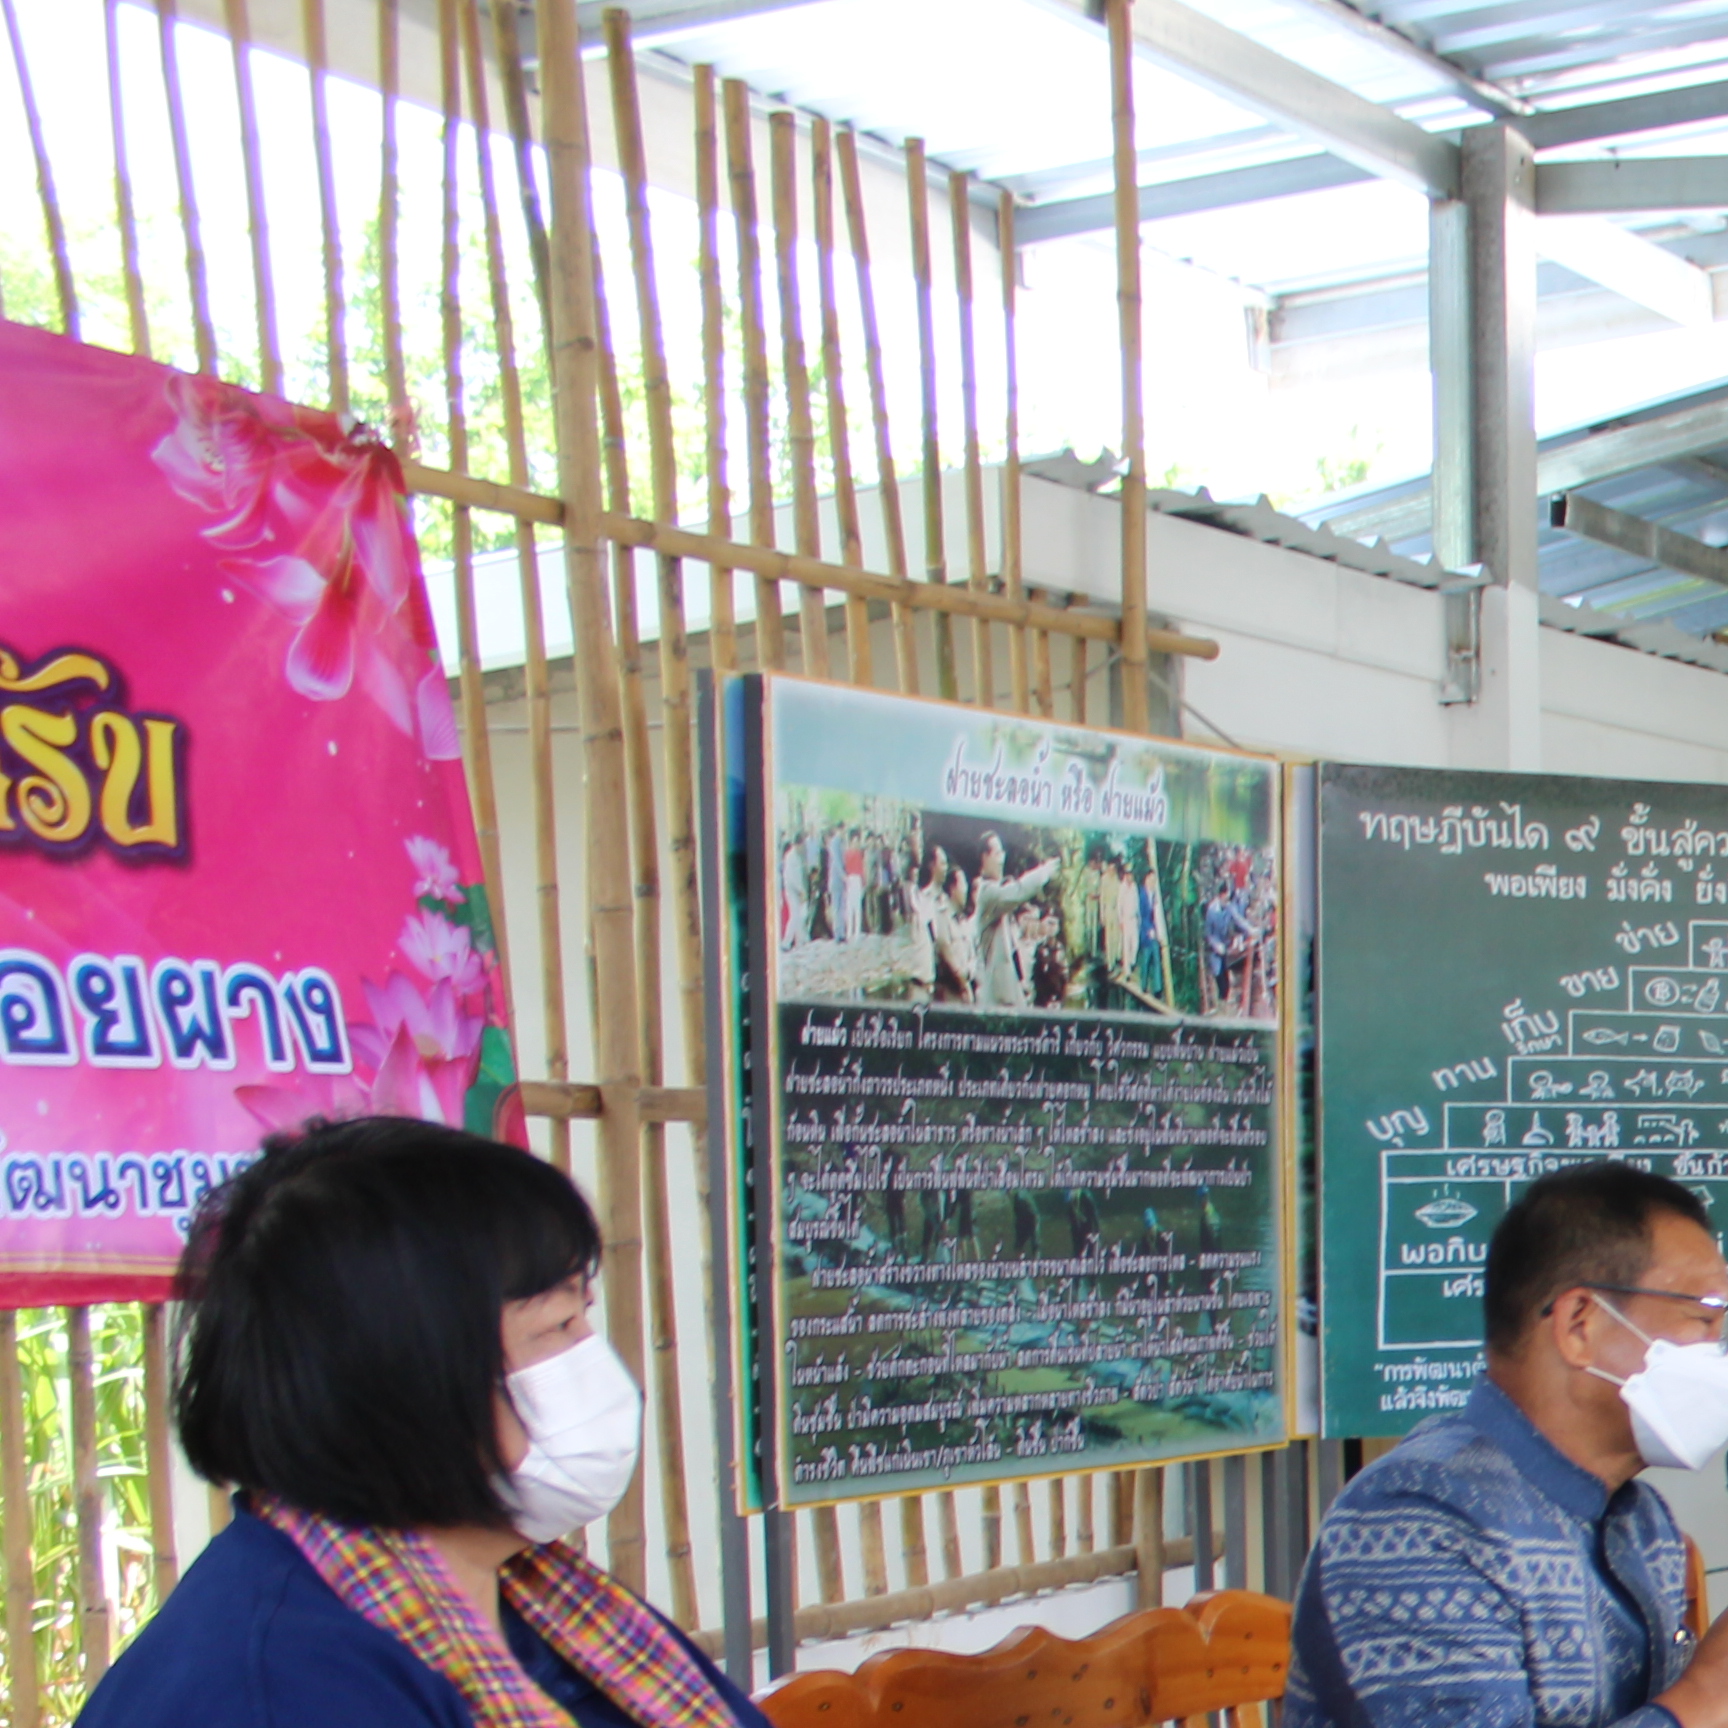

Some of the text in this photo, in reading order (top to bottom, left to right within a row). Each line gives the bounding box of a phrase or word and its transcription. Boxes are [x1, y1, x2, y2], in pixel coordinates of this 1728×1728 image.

[1360, 801, 1549, 854] ทฤษฎีบันได
[1564, 815, 1601, 853] ๙
[1485, 865, 1588, 900] พอเพียง
[1606, 860, 1673, 902] มั่งคั่ง
[1615, 920, 1681, 954] ข่าย
[1559, 965, 1621, 998] ขาย
[1501, 997, 1561, 1044] เก็บ
[1431, 1056, 1498, 1092] ทาน
[1365, 1104, 1431, 1148] บุญ
